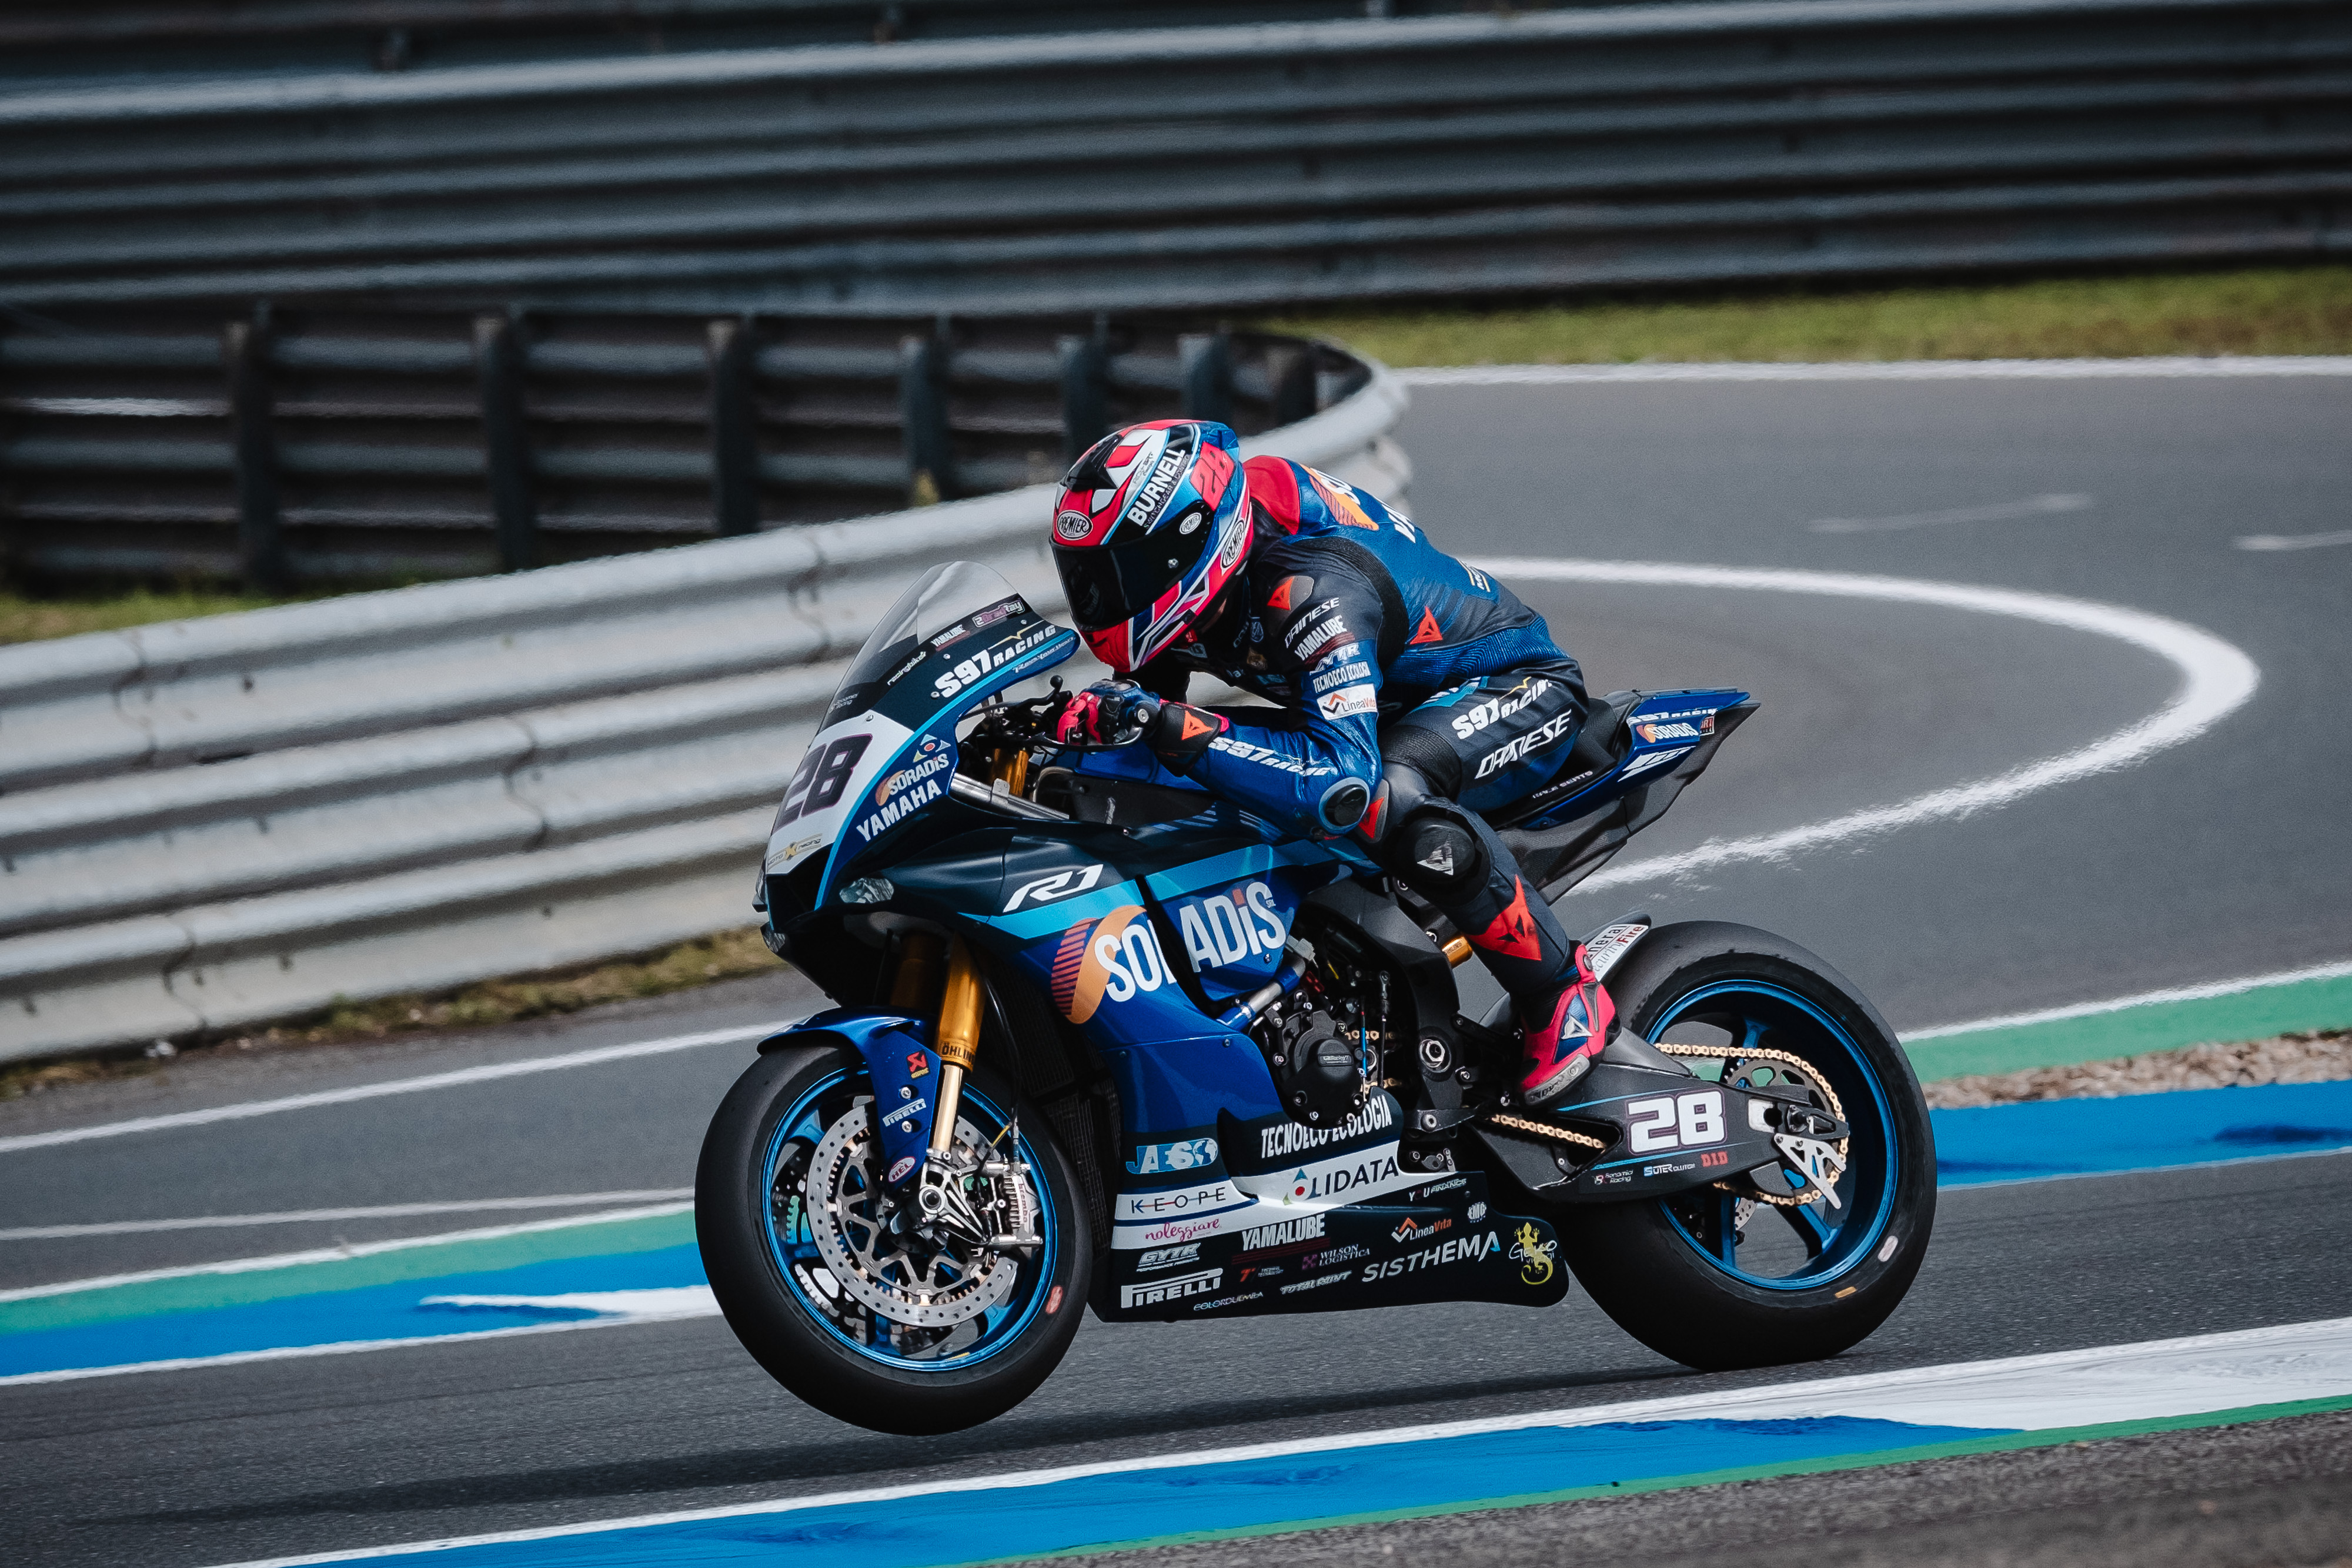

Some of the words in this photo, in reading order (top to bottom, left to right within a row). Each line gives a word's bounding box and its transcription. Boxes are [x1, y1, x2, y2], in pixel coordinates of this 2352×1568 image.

[1127, 449, 1185, 526] BURNELL
[1190, 442, 1235, 511] 28
[1060, 515, 1088, 534] PREMIER
[1225, 523, 1244, 564] PREMIER
[1284, 597, 1340, 648] DAINESE
[1294, 614, 1347, 661] YAMALUBE
[935, 650, 992, 698] S97
[993, 625, 1056, 668] RACING
[1452, 698, 1500, 739] S97
[1671, 708, 1718, 718] RACIN
[1208, 737, 1275, 761] S97
[1474, 708, 1572, 779] DAINESE
[772, 733, 873, 834] 28
[857, 779, 942, 842] YAMAHA
[1003, 864, 1104, 912] R1
[1587, 926, 1627, 958] neral
[883, 1098, 926, 1127] PIRELLI
[1628, 1091, 1726, 1153] 28
[891, 1163, 912, 1181] HEL
[1131, 1187, 1226, 1213] KEOPE
[1145, 1218, 1220, 1242] noleggiare
[1242, 1213, 1325, 1251] YAMALUBE
[1138, 1242, 1201, 1264] GYTR
[1319, 1248, 1371, 1266] LOGISTICA
[1320, 1243, 1359, 1259] WILSON
[1362, 1231, 1501, 1282] SISTHEMA
[1121, 1268, 1224, 1308] PIRELLI
